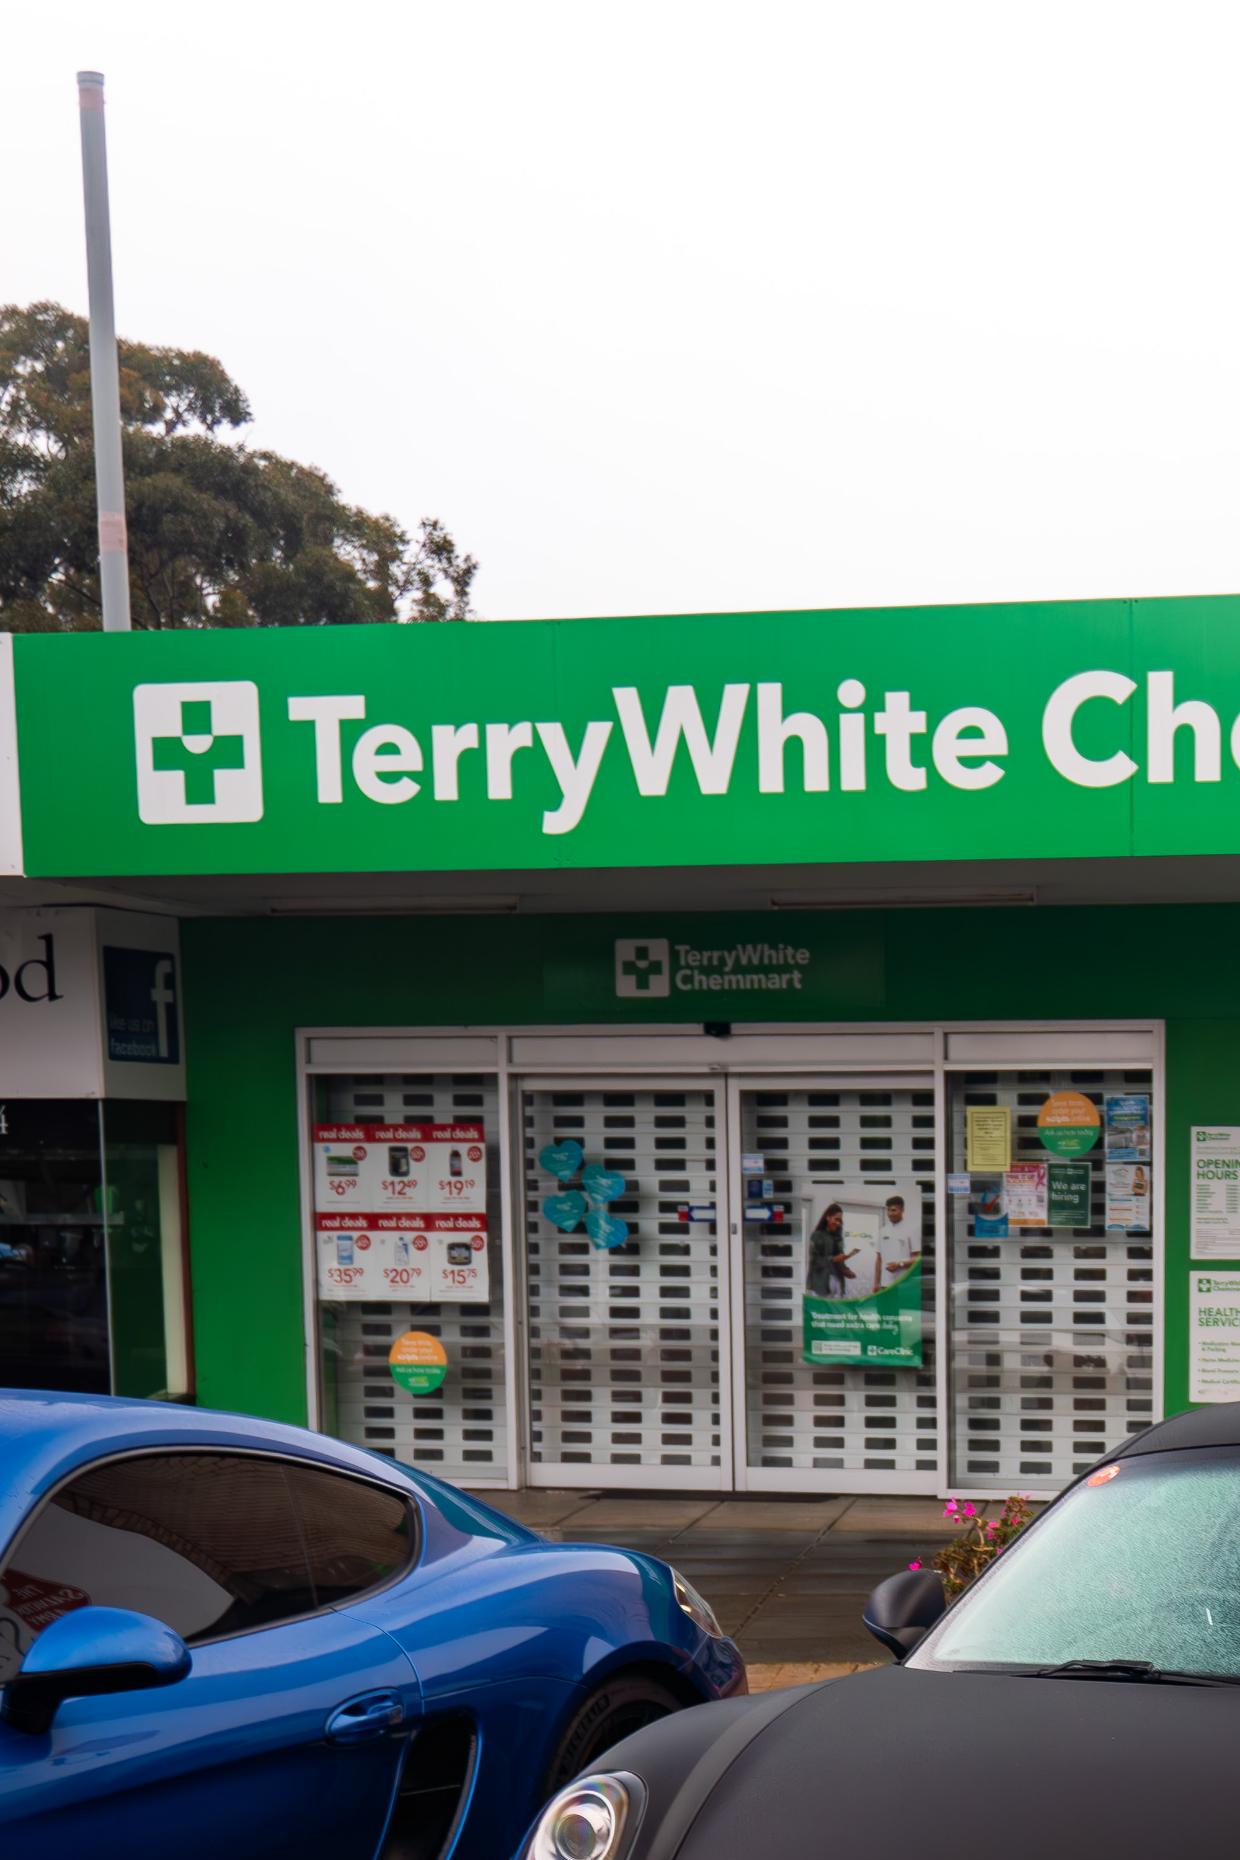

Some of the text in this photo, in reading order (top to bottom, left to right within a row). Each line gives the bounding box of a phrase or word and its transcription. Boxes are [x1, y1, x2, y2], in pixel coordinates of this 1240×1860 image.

[287, 680, 1009, 834] TerryWhite
[674, 944, 811, 972] TerryWhite
[0, 933, 64, 1002] d
[674, 969, 803, 991] Chemmart
[110, 1037, 157, 1056] facebook
[319, 1128, 365, 1140] real deals
[375, 1128, 421, 1140] real deals
[432, 1128, 479, 1140] real deals
[1196, 1170, 1239, 1180] HOURS
[1051, 1180, 1087, 1191] We are
[1051, 1193, 1079, 1204] hiring
[321, 1216, 368, 1228] real deals
[379, 1216, 424, 1229] real deals
[435, 1217, 481, 1229] real deals
